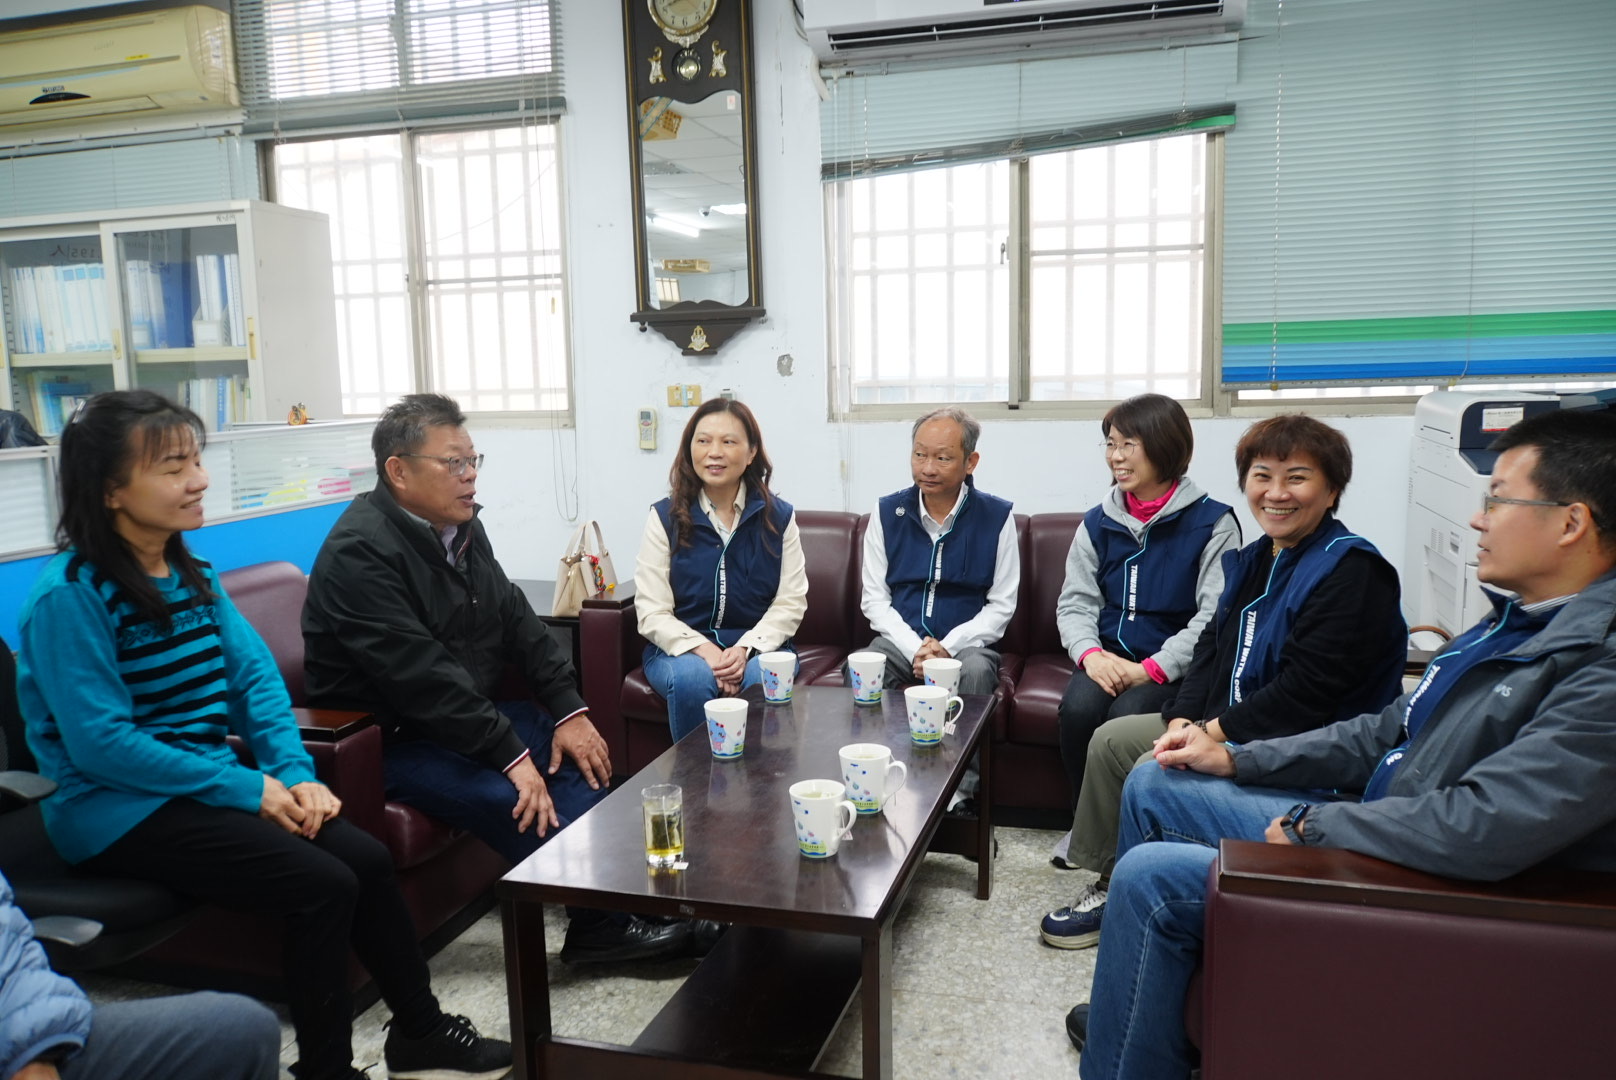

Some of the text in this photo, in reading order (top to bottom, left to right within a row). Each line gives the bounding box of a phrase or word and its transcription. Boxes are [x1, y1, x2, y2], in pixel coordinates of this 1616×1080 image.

[1129, 564, 1138, 594] TAIWAN
[1234, 610, 1257, 703] TAIWAN WATER CORP
